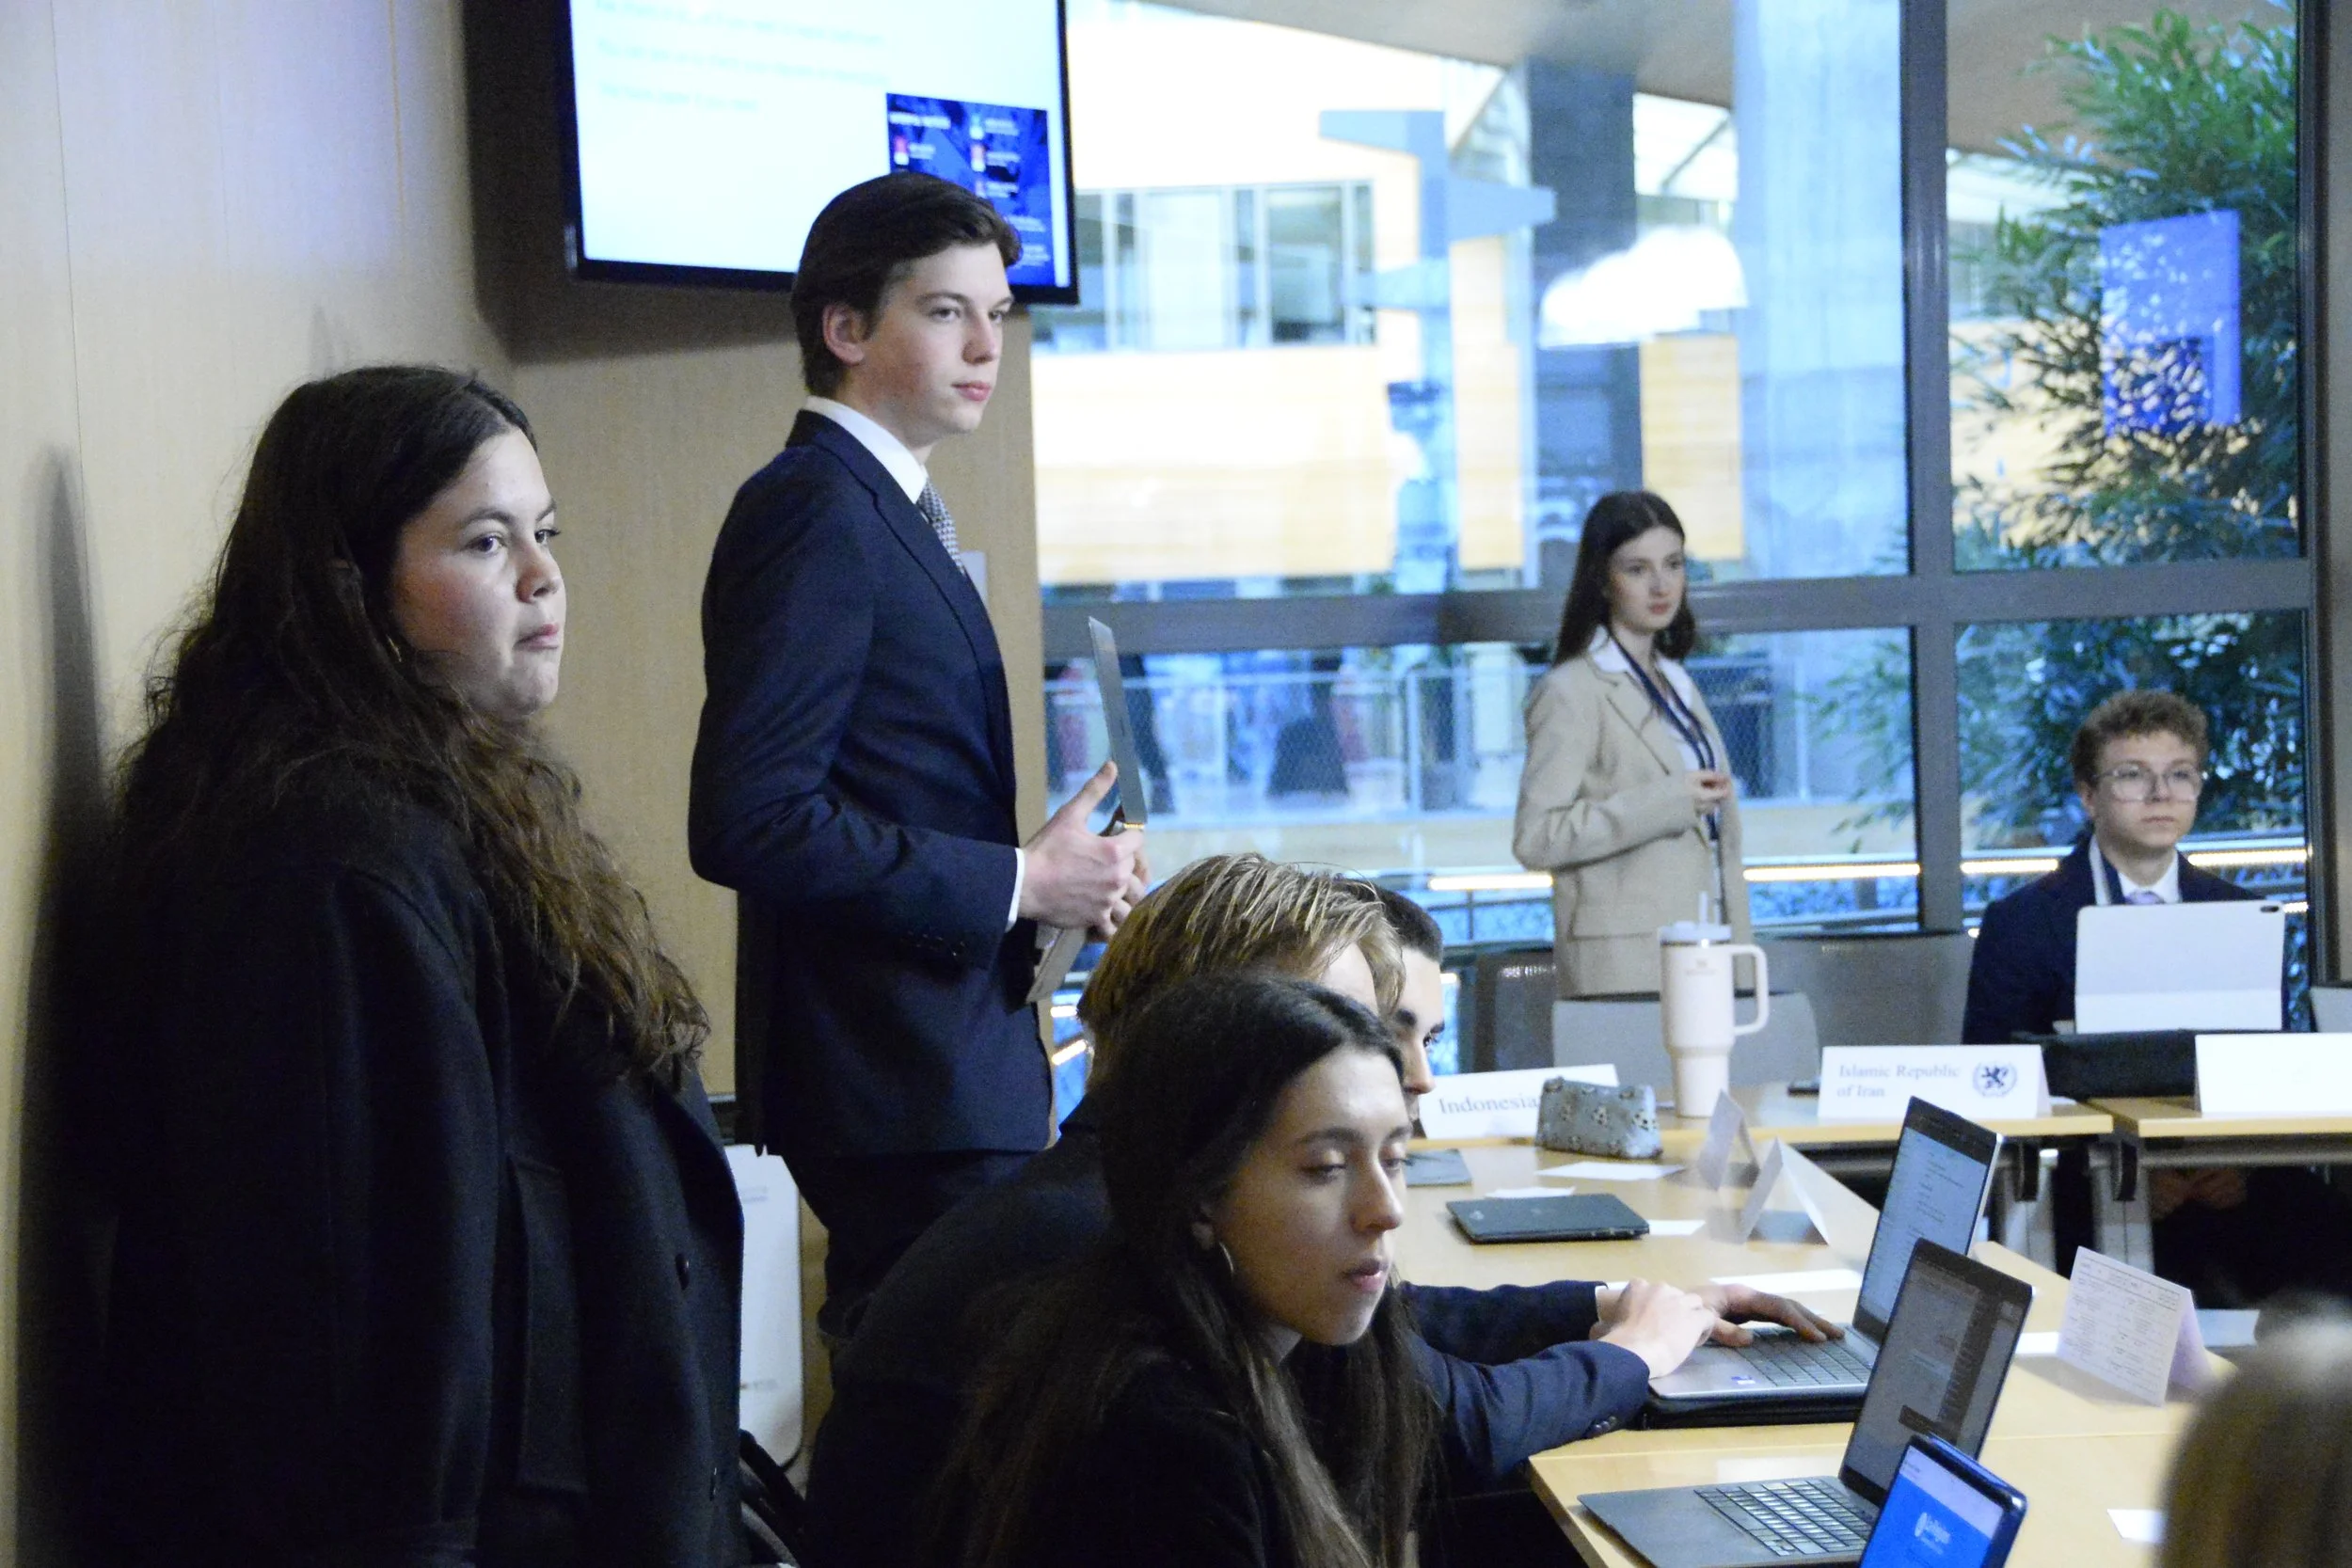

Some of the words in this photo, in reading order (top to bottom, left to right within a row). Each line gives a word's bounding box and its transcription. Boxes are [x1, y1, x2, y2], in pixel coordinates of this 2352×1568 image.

[1838, 1064, 1890, 1078] Islamic
[1896, 1064, 1961, 1081] Republic
[1836, 1085, 1854, 1098] of
[1857, 1085, 1885, 1098] Iran
[1438, 1094, 1539, 1115] Indonesia
